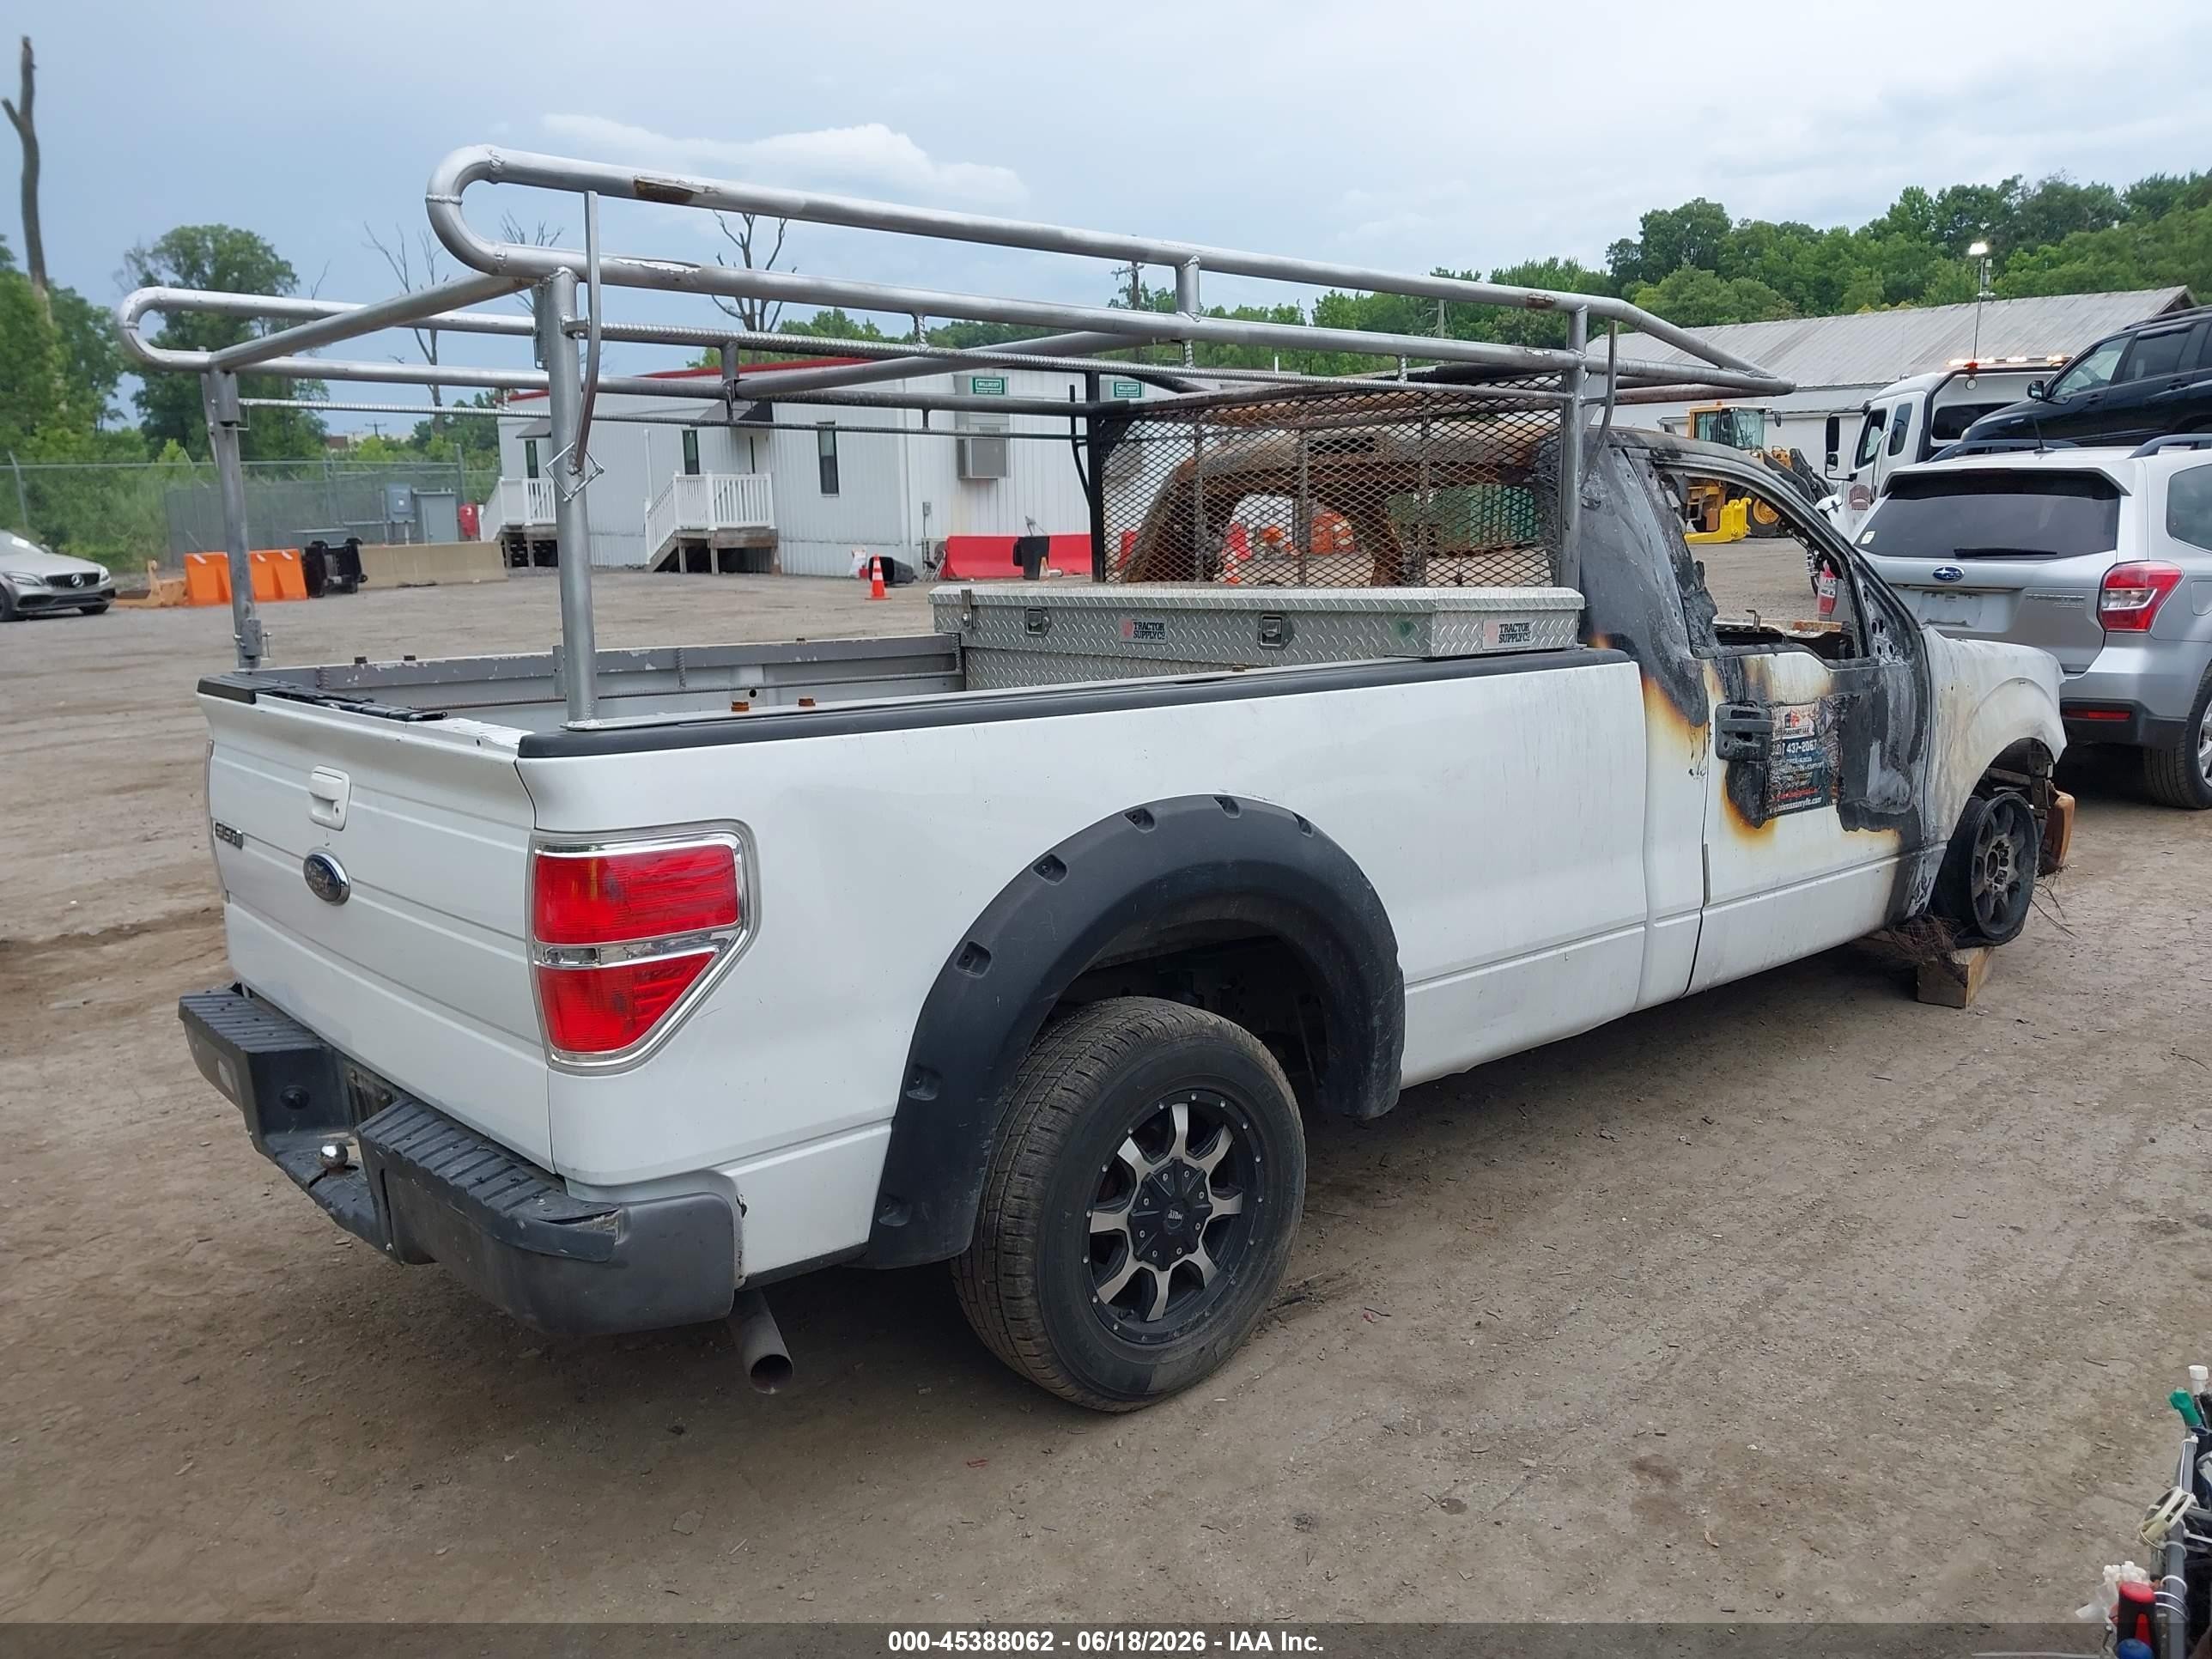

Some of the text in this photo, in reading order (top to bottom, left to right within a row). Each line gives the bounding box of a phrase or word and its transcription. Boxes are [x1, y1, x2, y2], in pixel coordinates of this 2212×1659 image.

[1133, 622, 1164, 631] TRACTOR
[1498, 623, 1530, 634] TRACTOR
[1133, 630, 1158, 640] SUPPLY
[1498, 633, 1522, 644] SUPPLY
